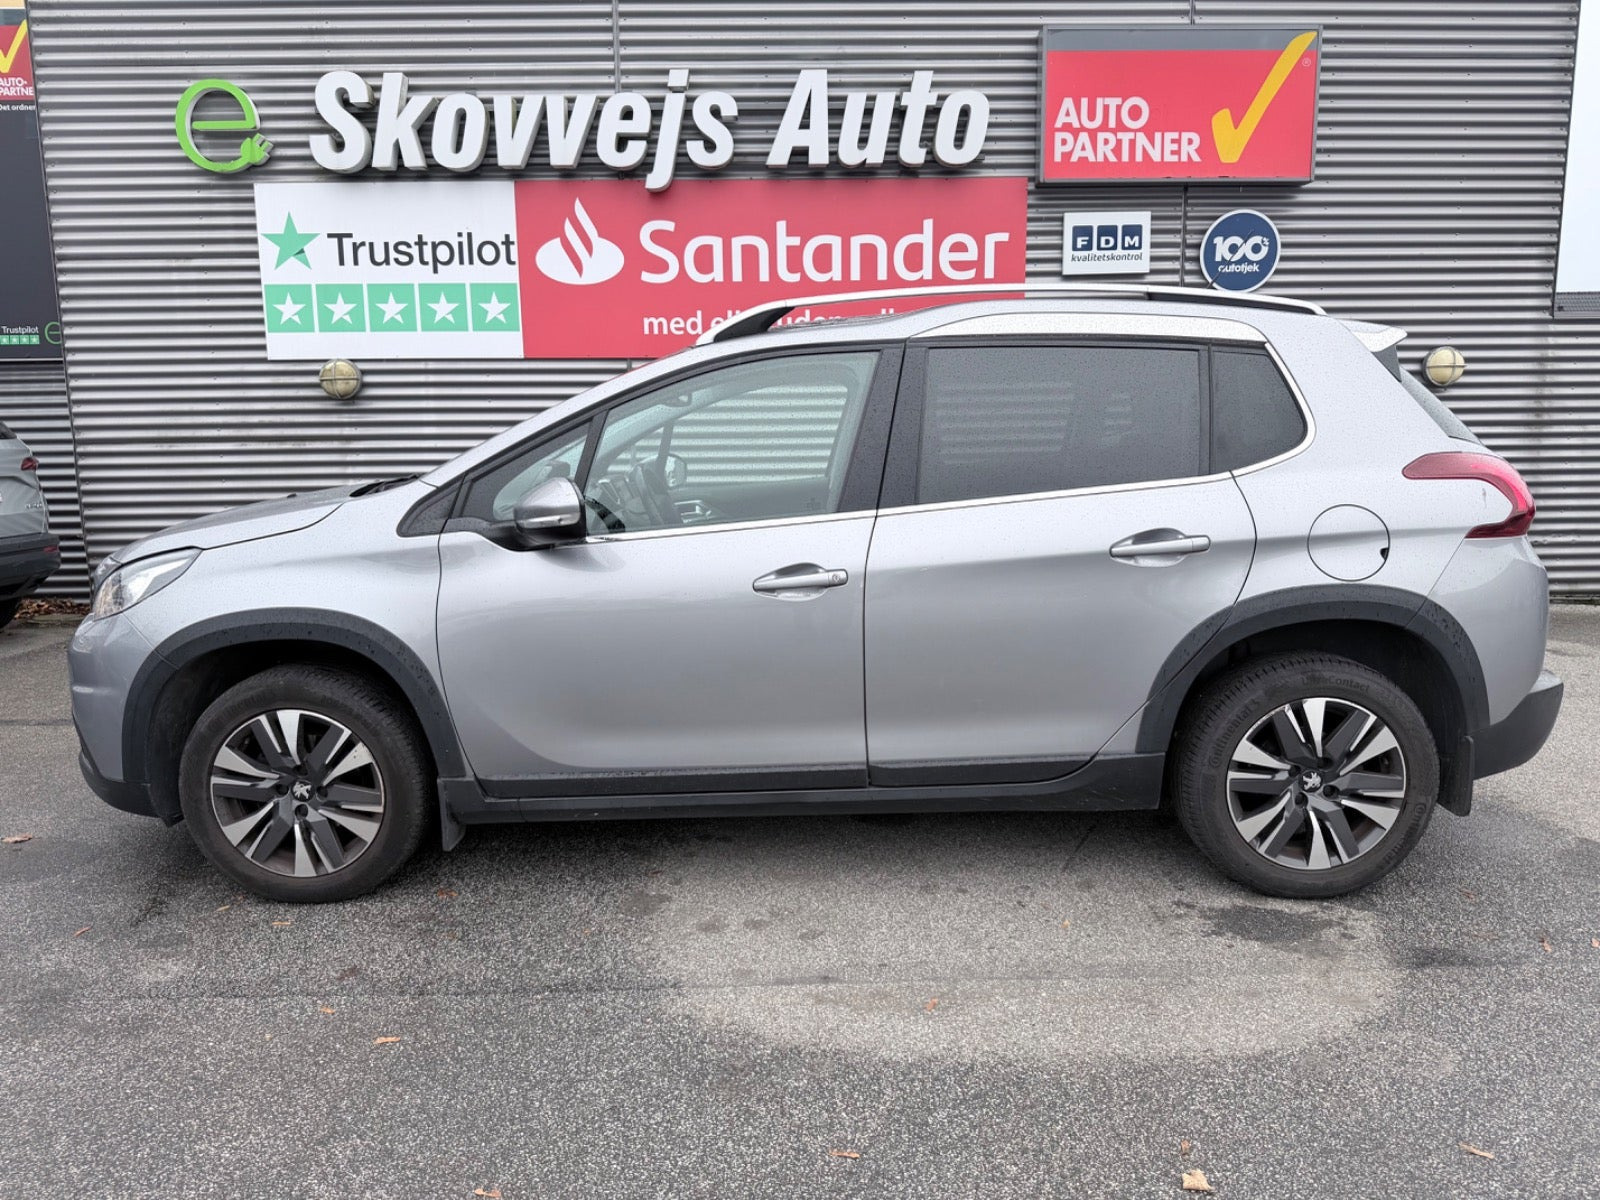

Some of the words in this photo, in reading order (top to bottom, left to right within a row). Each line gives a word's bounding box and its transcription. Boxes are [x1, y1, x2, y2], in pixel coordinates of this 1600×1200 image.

[1054, 96, 1150, 130] AUTO
[309, 69, 739, 193] Skovvejs
[765, 69, 990, 168] Auto
[1053, 131, 1202, 163] PARTNER
[326, 231, 517, 274] Trustpilot
[639, 218, 1010, 284] Santander
[1071, 252, 1143, 262] kvalitetskontrol
[1076, 235, 1140, 249] FDM
[1, 325, 39, 334] Trustpilot
[642, 309, 703, 335] med
